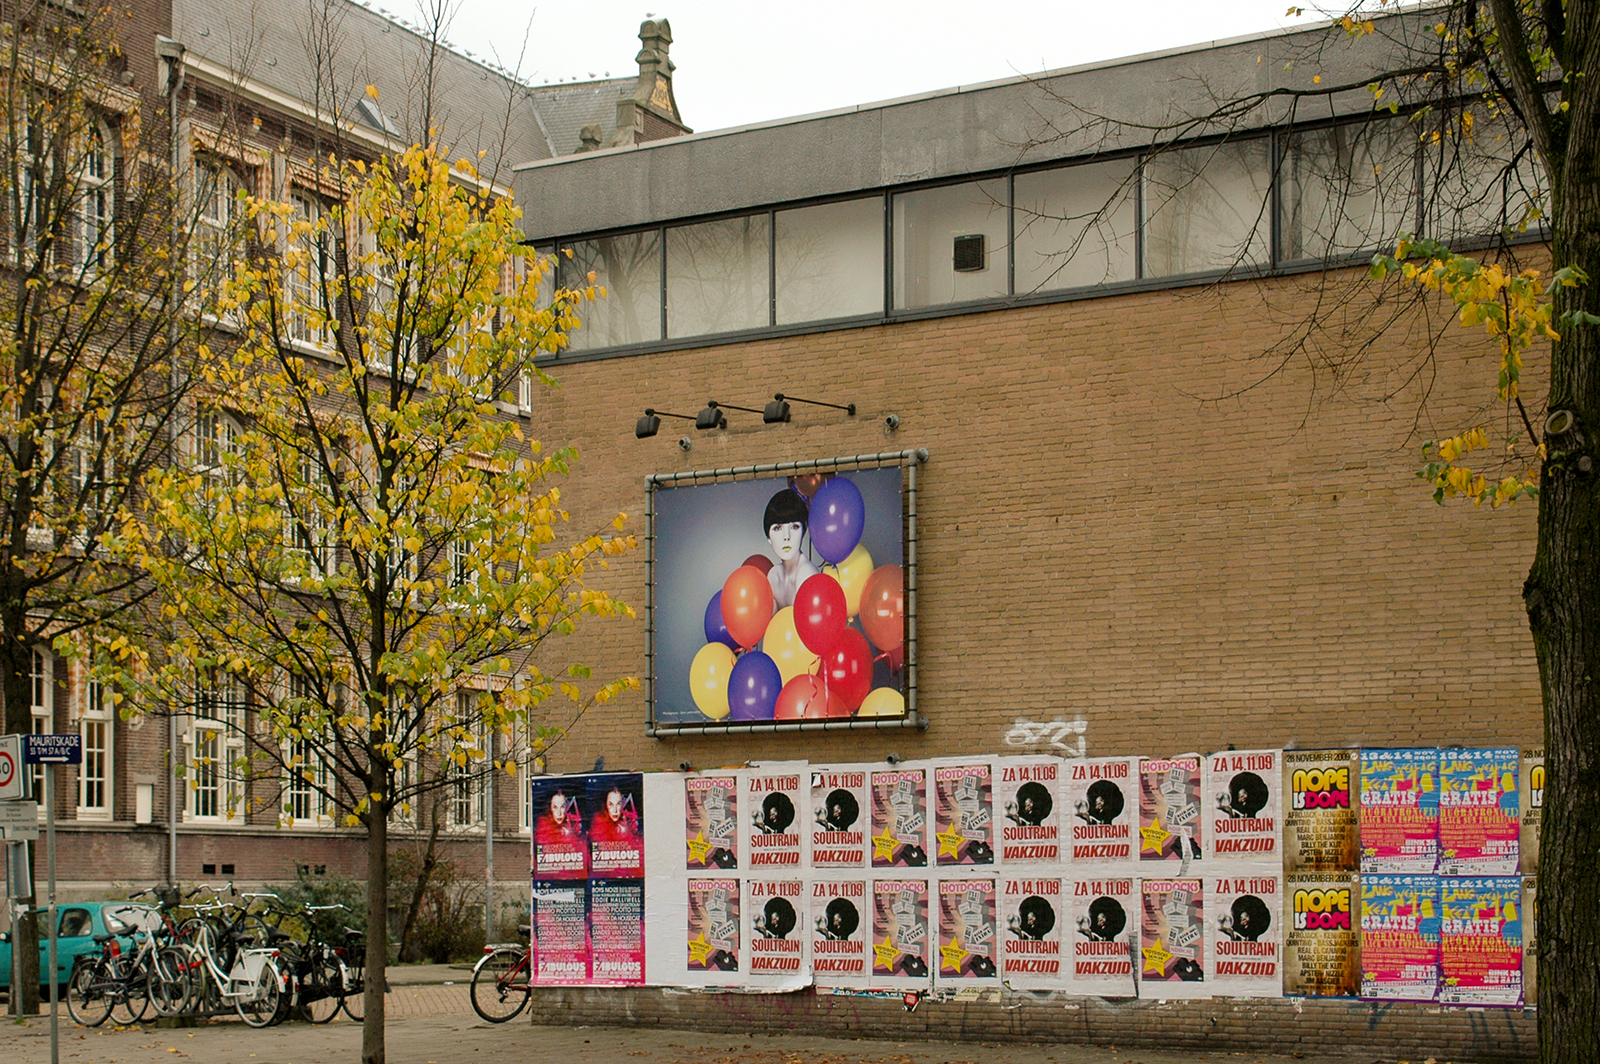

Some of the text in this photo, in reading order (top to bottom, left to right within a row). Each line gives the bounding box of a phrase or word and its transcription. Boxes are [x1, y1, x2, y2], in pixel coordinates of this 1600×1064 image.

[29, 736, 79, 746] MAURITSKADE
[1296, 753, 1331, 761] NOVEMBER
[1334, 752, 1349, 760] 2009
[1524, 750, 1535, 758] 28
[1141, 760, 1196, 772] HOTDOCKS
[1214, 758, 1227, 771] ZA
[1232, 755, 1272, 770] 14.11.09
[873, 772, 922, 784] HOTDOCKS
[937, 767, 987, 779] HOTDOCKS
[1003, 766, 1055, 781] ZA 14.11.09
[1073, 764, 1127, 779] ZA 14.11.09
[688, 779, 733, 789] HOTDOCKS
[751, 777, 797, 791] ZA 14.11.09
[829, 774, 862, 787] 14.11.09
[1293, 768, 1347, 791] NOPE
[1293, 790, 1348, 808] IS DOPE
[1361, 790, 1415, 804] GRATIS
[1440, 790, 1496, 805] GRATIS
[1074, 825, 1128, 839] SOULTRAIN
[1215, 818, 1273, 833] SOULTRAIN
[814, 832, 862, 844] SOULTRAIN
[1004, 826, 1056, 840] SOULTRAIN
[752, 834, 798, 847] SOULTRAIN
[1216, 838, 1274, 852] VAKZUID
[592, 850, 639, 860] FABULOUS
[1004, 845, 1057, 858] VAKZUID
[1074, 844, 1129, 858] VAKZUID
[1400, 845, 1415, 853] DEN
[1481, 846, 1496, 854] DEN
[537, 852, 583, 862] FABULOUS
[752, 852, 799, 864] VAKZUID
[814, 850, 863, 862] VAKZUID
[1297, 874, 1333, 882] NOVEMBER
[1335, 874, 1350, 882] 2009
[690, 881, 735, 890] HOTDOCKS
[753, 883, 800, 896] ZA 14.11.09
[814, 883, 862, 896] ZA 14.11.09
[876, 882, 924, 892] HOTDOCKS
[941, 882, 991, 892] HOTDOCKS
[1006, 881, 1059, 894] ZA 14.11.09
[1075, 881, 1129, 895] ZA 14.11.09
[1144, 882, 1198, 892] HOTDOCKS
[1217, 880, 1274, 893] ZA 14.11.09
[1294, 889, 1349, 912] NOPE
[1294, 911, 1349, 928] IS DOPE
[1361, 914, 1415, 930] GRATIS
[1442, 918, 1498, 934] GRATIS
[752, 939, 800, 951] SOULTRAIN
[814, 941, 863, 953] SOULTRAIN
[1006, 940, 1059, 953] SOULTRAIN
[1076, 942, 1129, 955] SOULTRAIN
[1217, 941, 1275, 955] SOULTRAIN
[538, 962, 585, 971] FABULOUS
[592, 961, 640, 970] FABULOUS
[752, 957, 800, 970] VAKZUID
[814, 959, 863, 971] VAKZUID
[1006, 959, 1059, 972] VAKZUID
[1076, 962, 1131, 974] VAKZUID
[1217, 962, 1275, 975] VAKZUID
[1400, 970, 1436, 979] DEN HAAG
[1483, 975, 1520, 984] DEN HAAG
